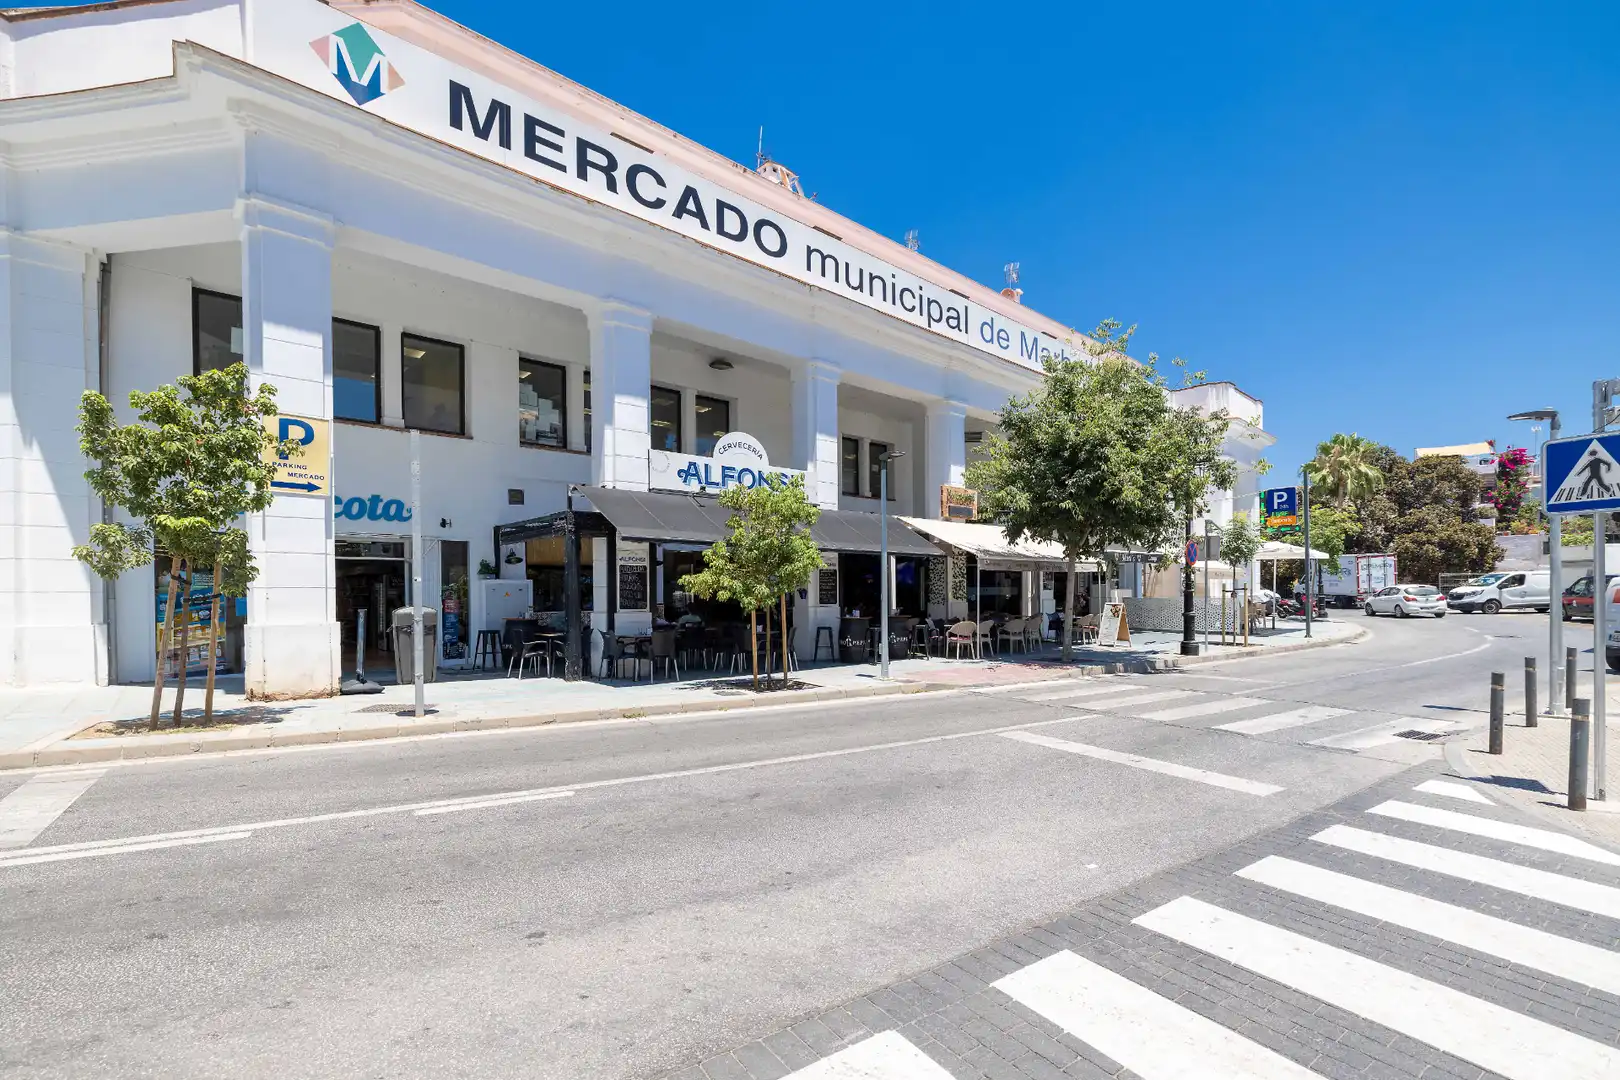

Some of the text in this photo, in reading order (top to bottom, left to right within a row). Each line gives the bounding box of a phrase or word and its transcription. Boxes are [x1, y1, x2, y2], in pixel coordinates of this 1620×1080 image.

[449, 79, 788, 259] MERCADO
[806, 244, 969, 334] municipal
[980, 317, 1010, 350] de
[278, 417, 315, 461] P
[271, 461, 308, 470] PARKING
[287, 472, 325, 481] MERCADO
[1273, 491, 1288, 510] P
